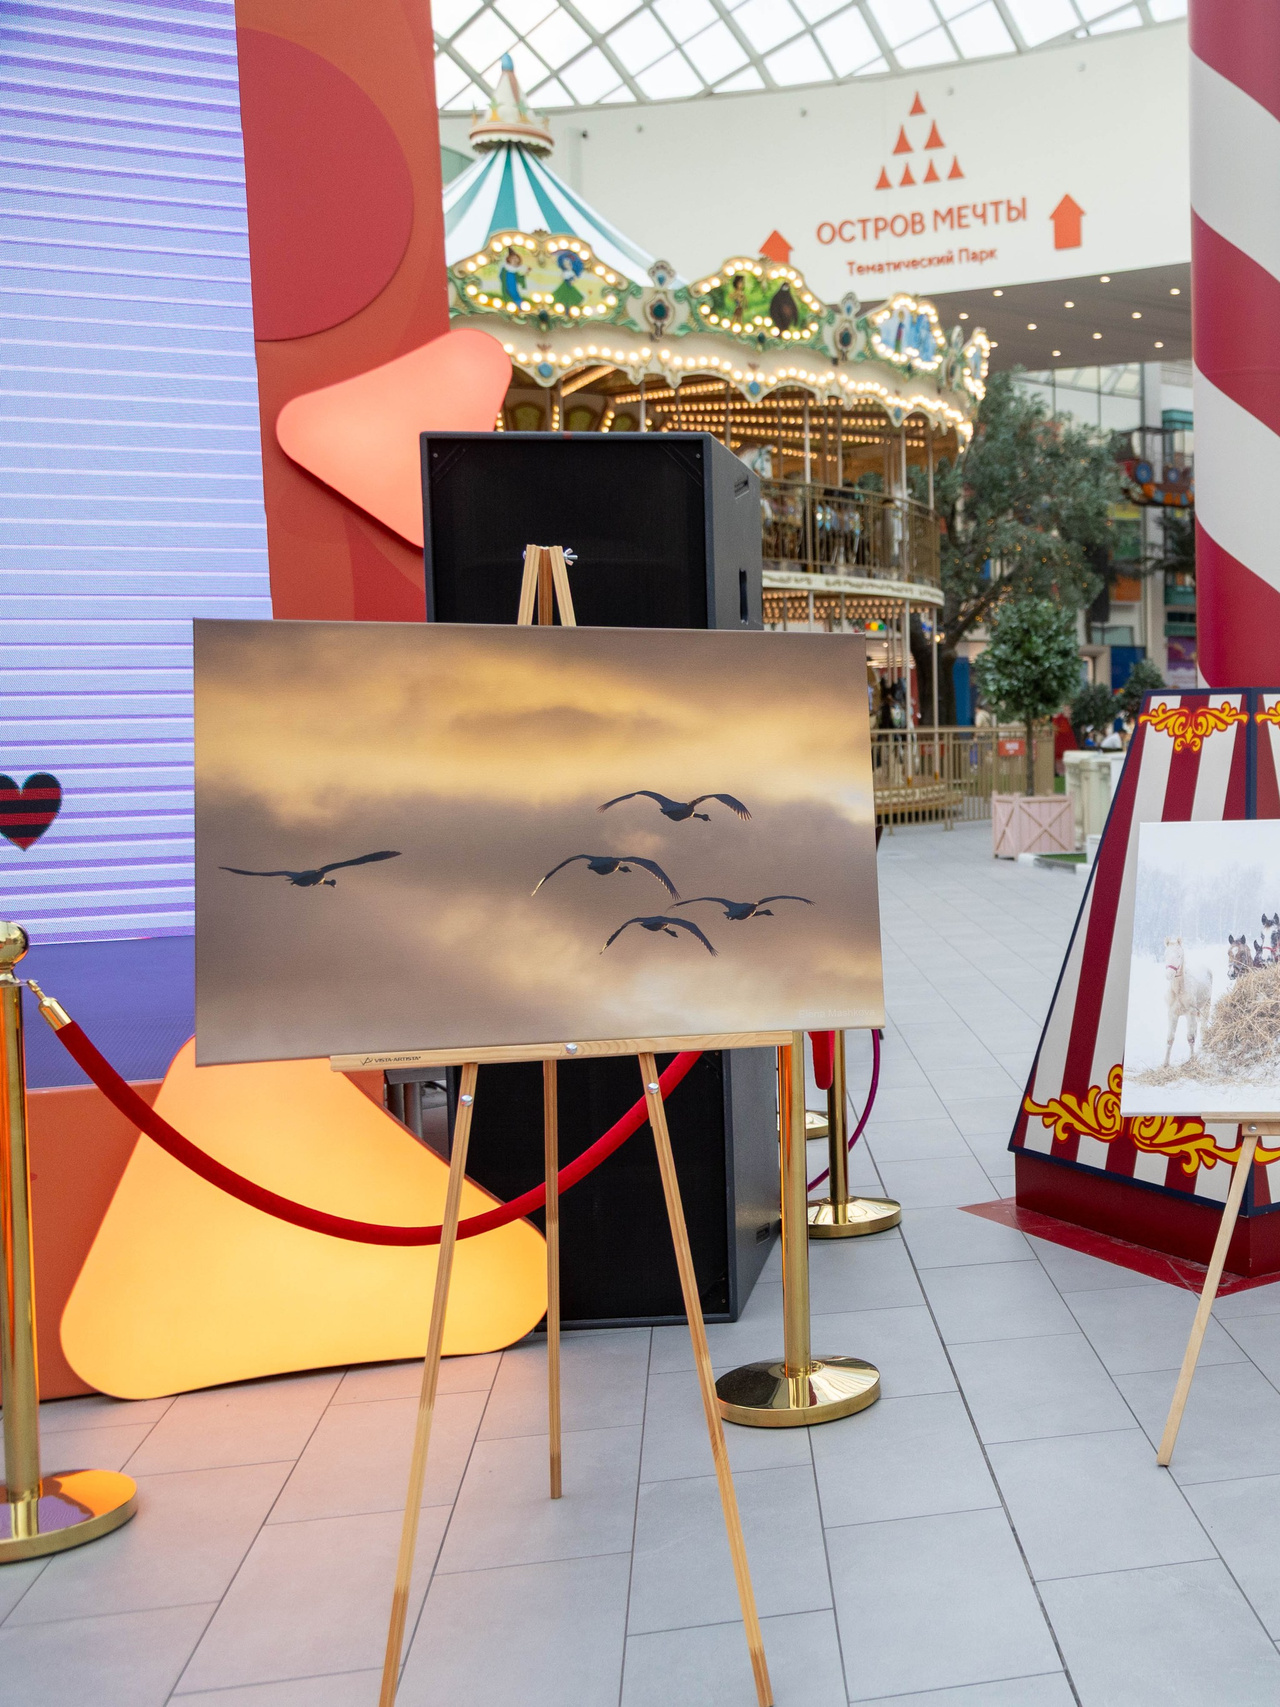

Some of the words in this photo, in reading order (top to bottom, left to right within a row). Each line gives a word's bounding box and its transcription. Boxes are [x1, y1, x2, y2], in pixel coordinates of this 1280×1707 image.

[816, 211, 925, 245] ОСТРОВ
[933, 197, 1027, 232] МЕЧТЫ
[847, 249, 954, 276] Тематический
[958, 247, 998, 265] Парк
[798, 1008, 826, 1019] Elena
[828, 1007, 876, 1018] Mashkova
